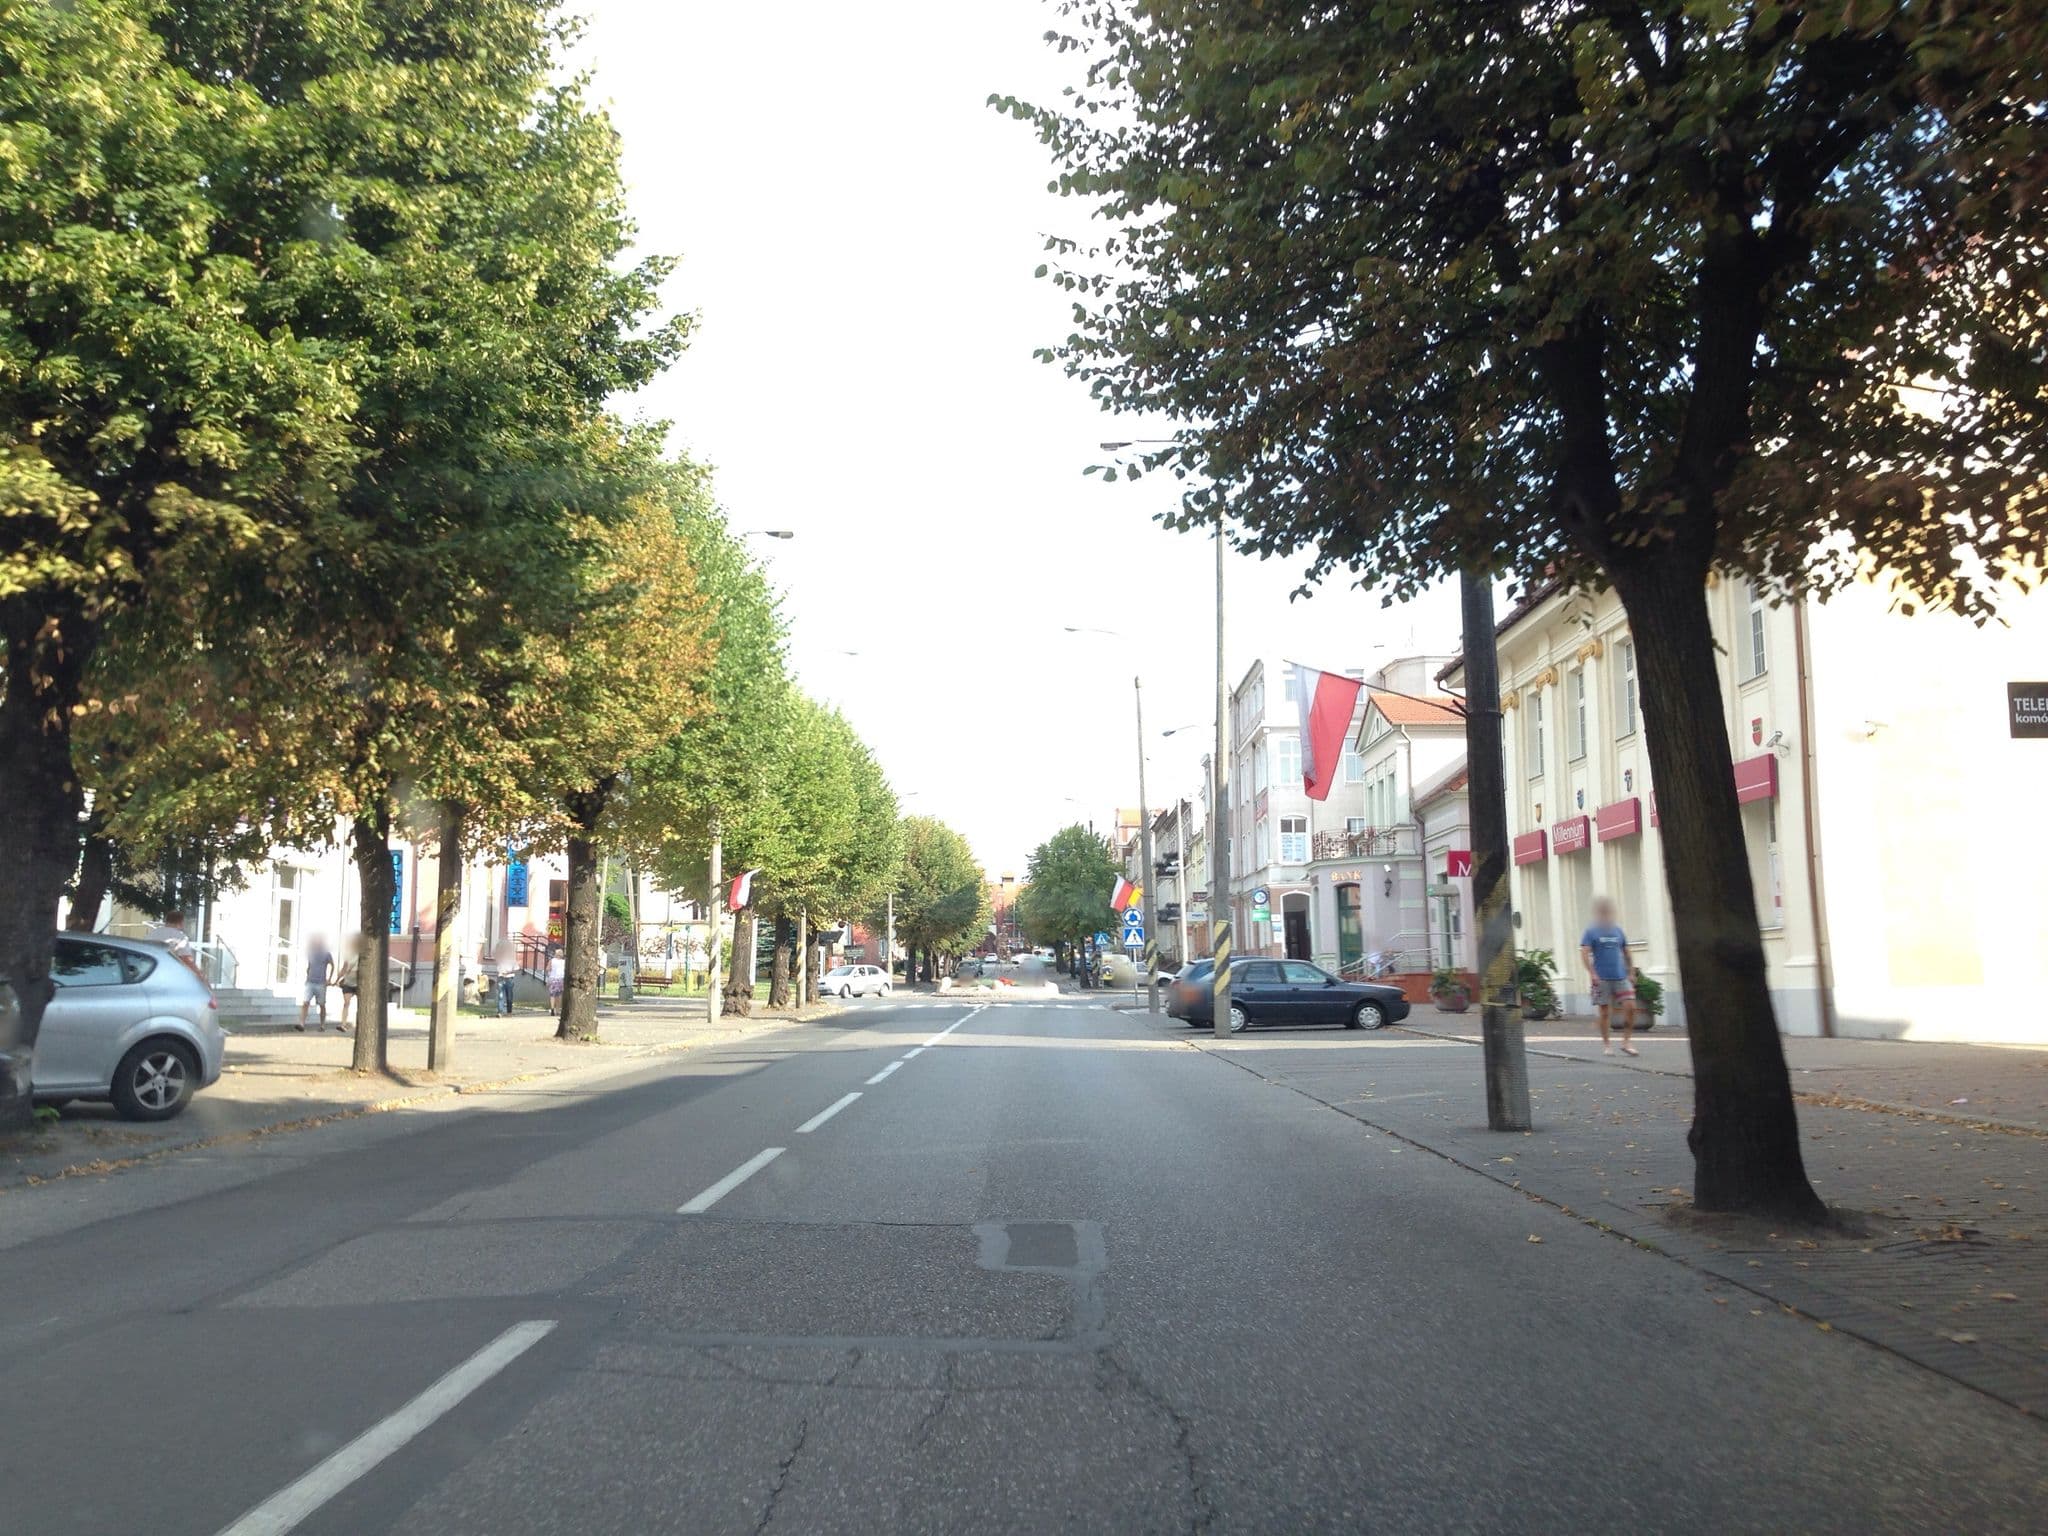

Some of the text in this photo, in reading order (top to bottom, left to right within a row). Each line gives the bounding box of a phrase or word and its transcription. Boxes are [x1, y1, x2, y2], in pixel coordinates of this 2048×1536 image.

[2013, 697, 2048, 711] TELE
[1553, 822, 1585, 842] Millennium
[1331, 870, 1361, 881] BANK
